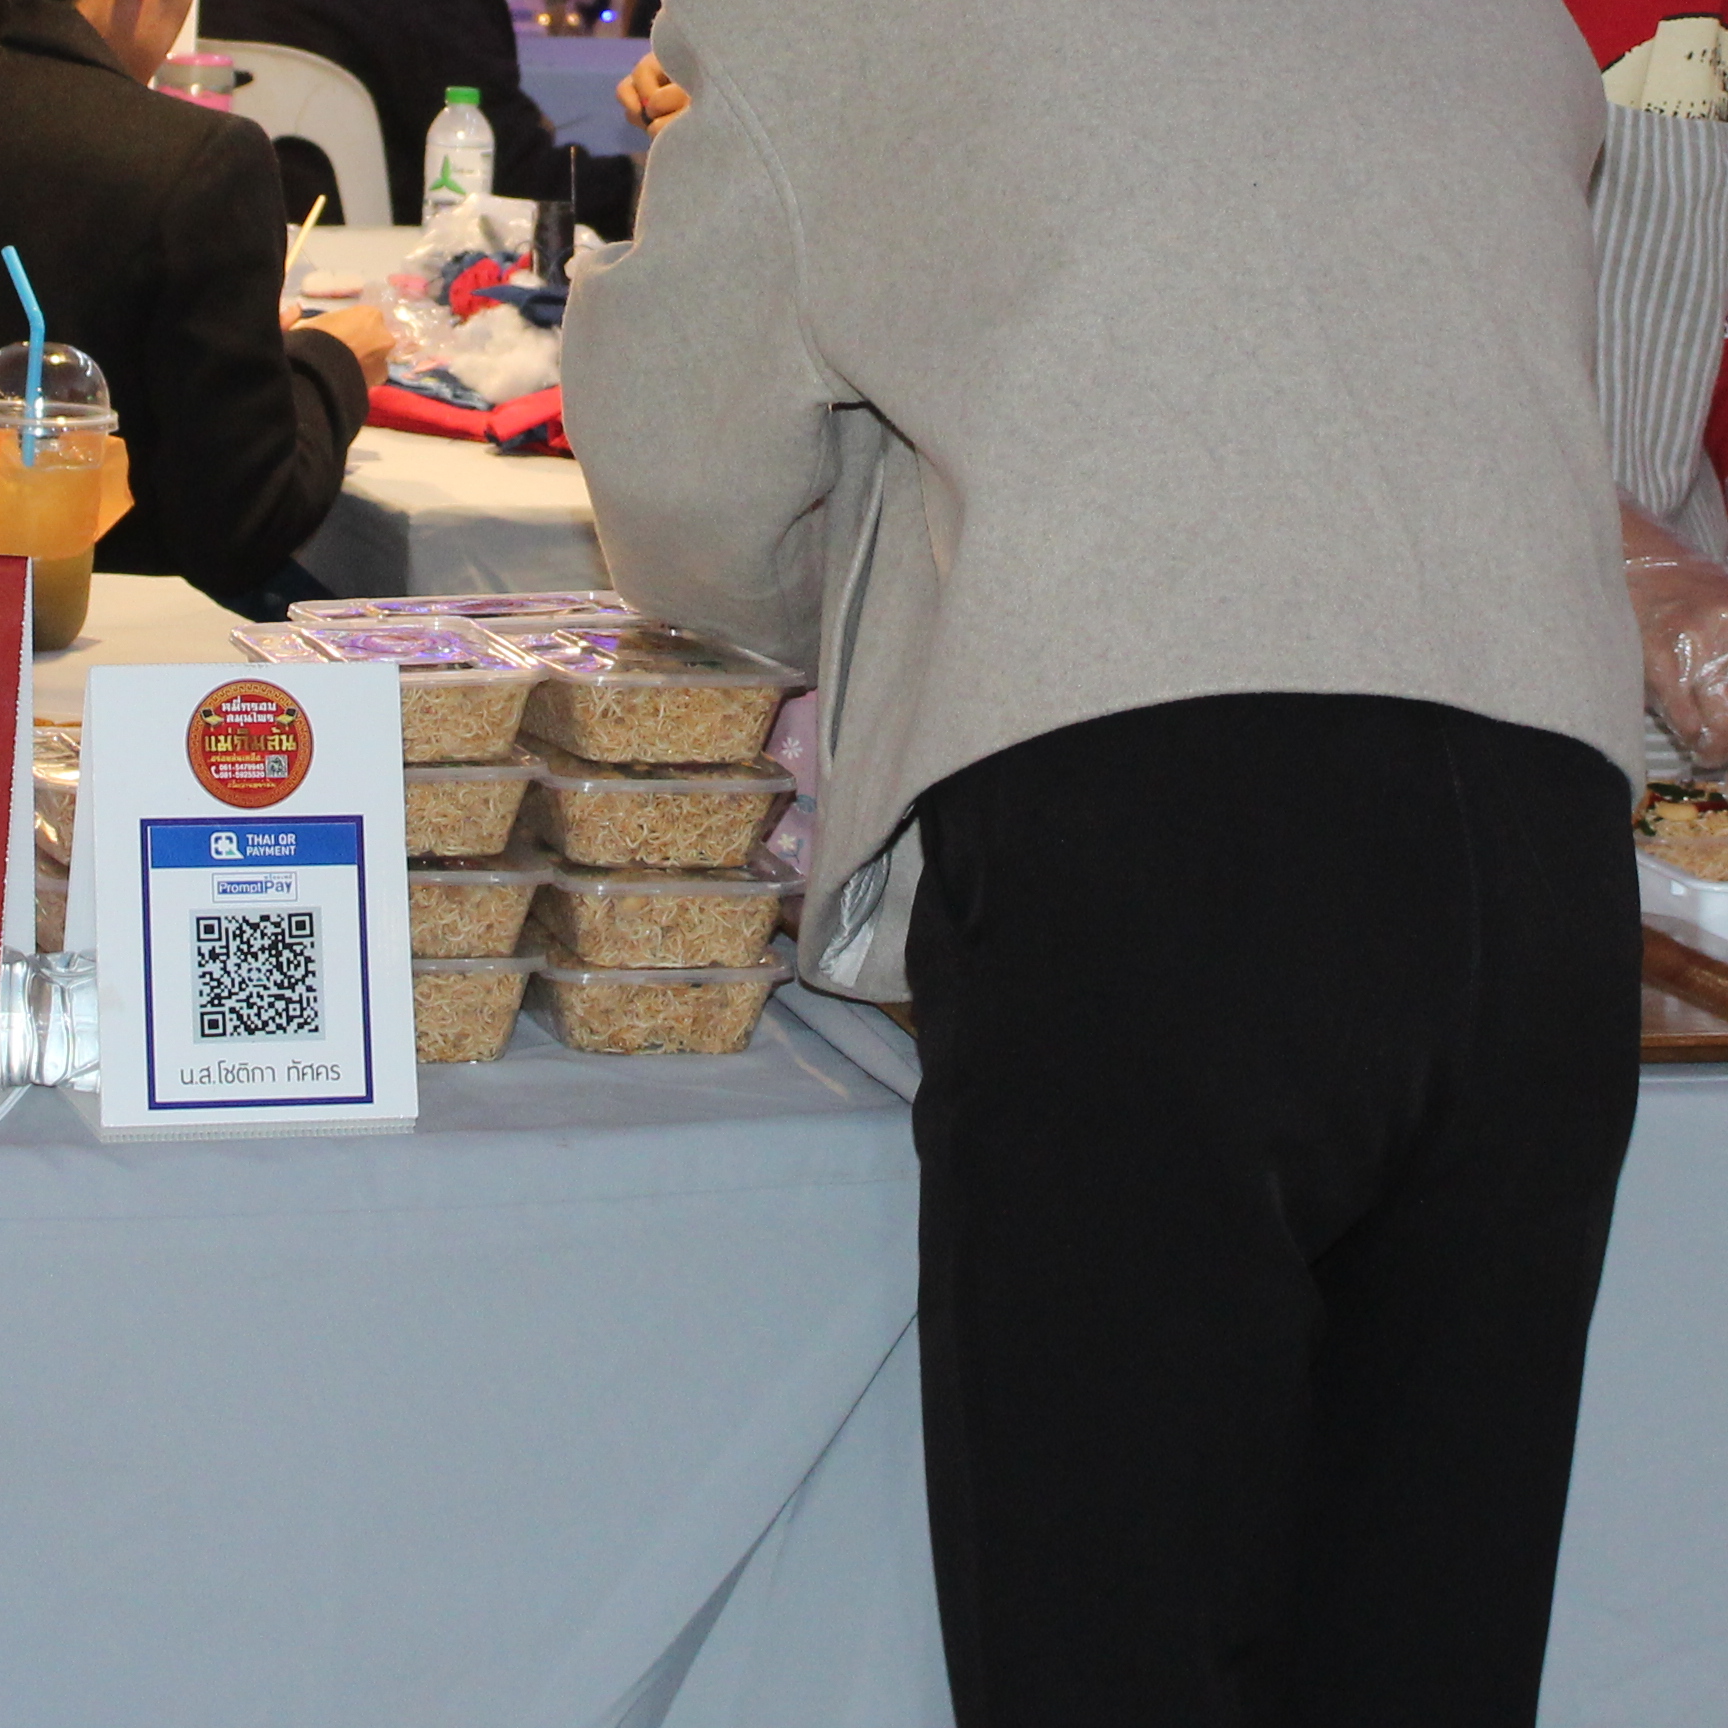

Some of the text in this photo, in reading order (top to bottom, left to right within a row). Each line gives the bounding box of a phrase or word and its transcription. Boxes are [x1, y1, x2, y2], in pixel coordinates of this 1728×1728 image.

[246, 834, 296, 846] THAI QR
[246, 846, 296, 857] PAYMENT
[179, 1059, 341, 1085] น.ส.โชติกา ทัศคร
